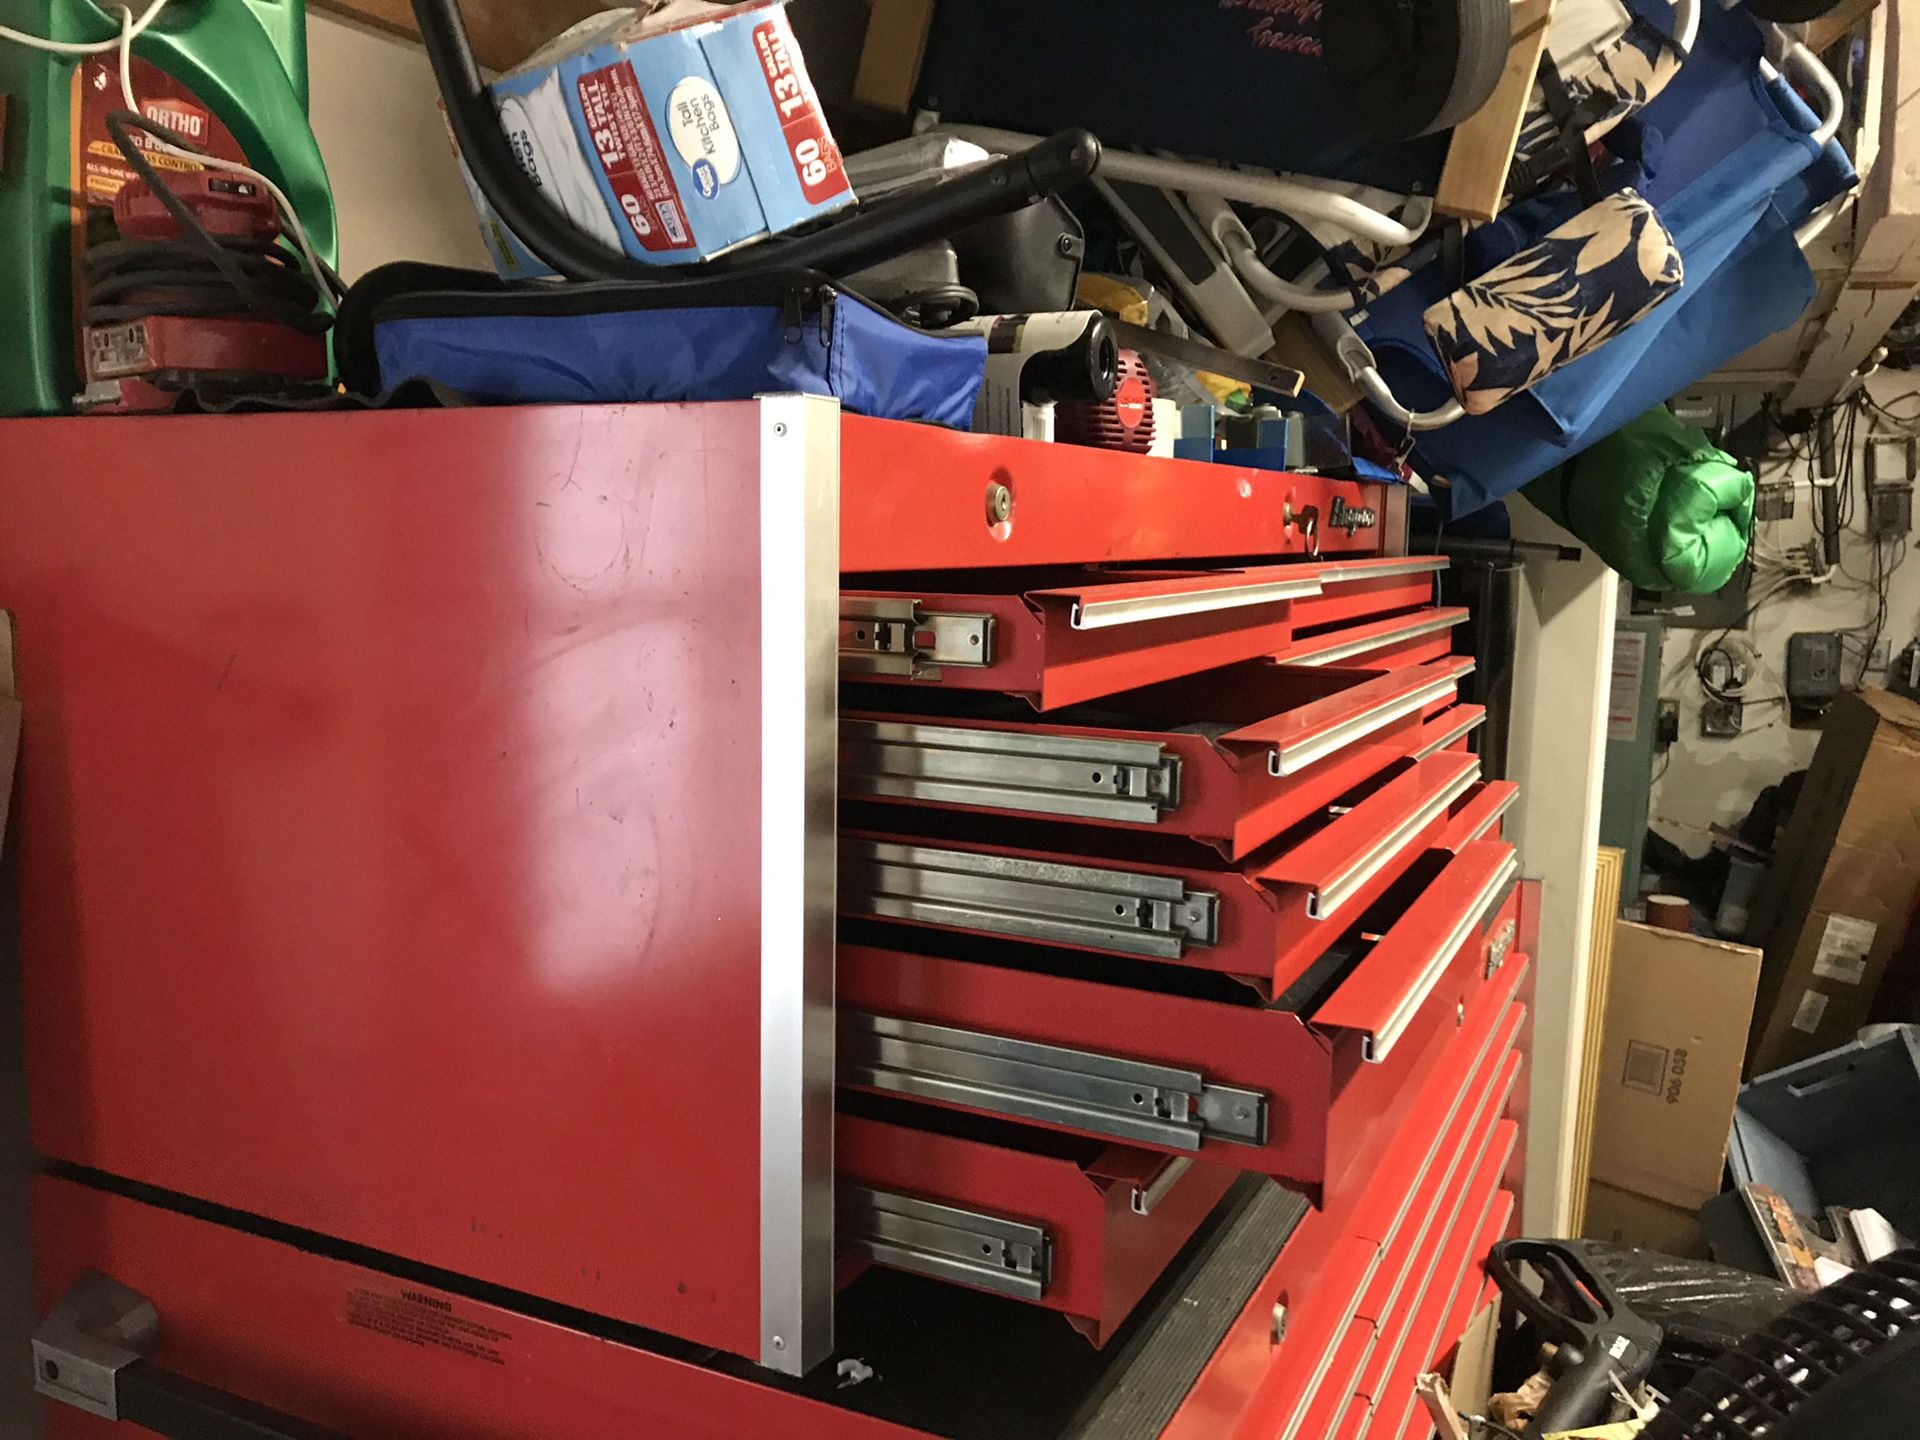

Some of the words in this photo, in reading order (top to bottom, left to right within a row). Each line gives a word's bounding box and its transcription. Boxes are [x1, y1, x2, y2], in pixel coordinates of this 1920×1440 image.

[756, 30, 778, 77] GALLON
[580, 83, 597, 127] GALLON
[586, 78, 607, 125] TALL
[598, 80, 611, 105] TIE
[675, 99, 693, 127] Tall
[699, 91, 721, 132] Bags
[772, 72, 805, 118] 13
[147, 106, 200, 136] ORTHO
[606, 111, 626, 159] TWIST
[688, 96, 715, 156] Kitchen
[520, 130, 542, 186] Bags
[593, 126, 620, 168] 13
[793, 136, 828, 187] 60
[619, 190, 651, 237] 60
[400, 1289, 453, 1312] WARNING
